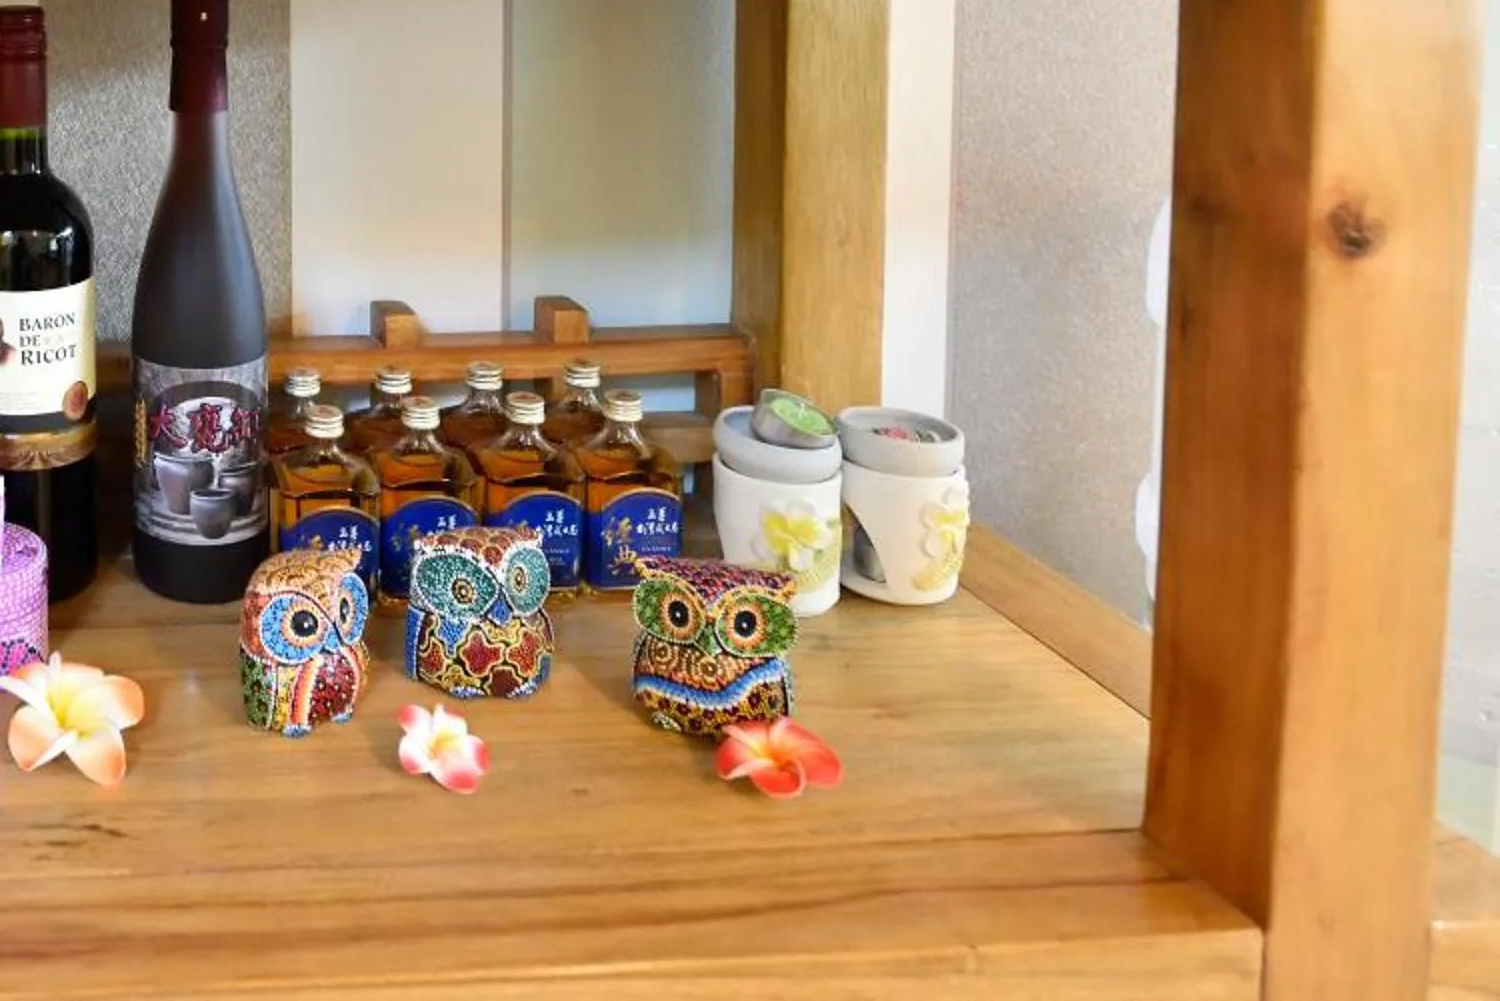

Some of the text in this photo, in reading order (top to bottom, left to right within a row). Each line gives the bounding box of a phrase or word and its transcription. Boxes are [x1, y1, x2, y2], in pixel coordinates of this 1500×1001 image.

[19, 312, 76, 332] BARON
[19, 335, 41, 348] DE
[21, 344, 77, 366] RICOT
